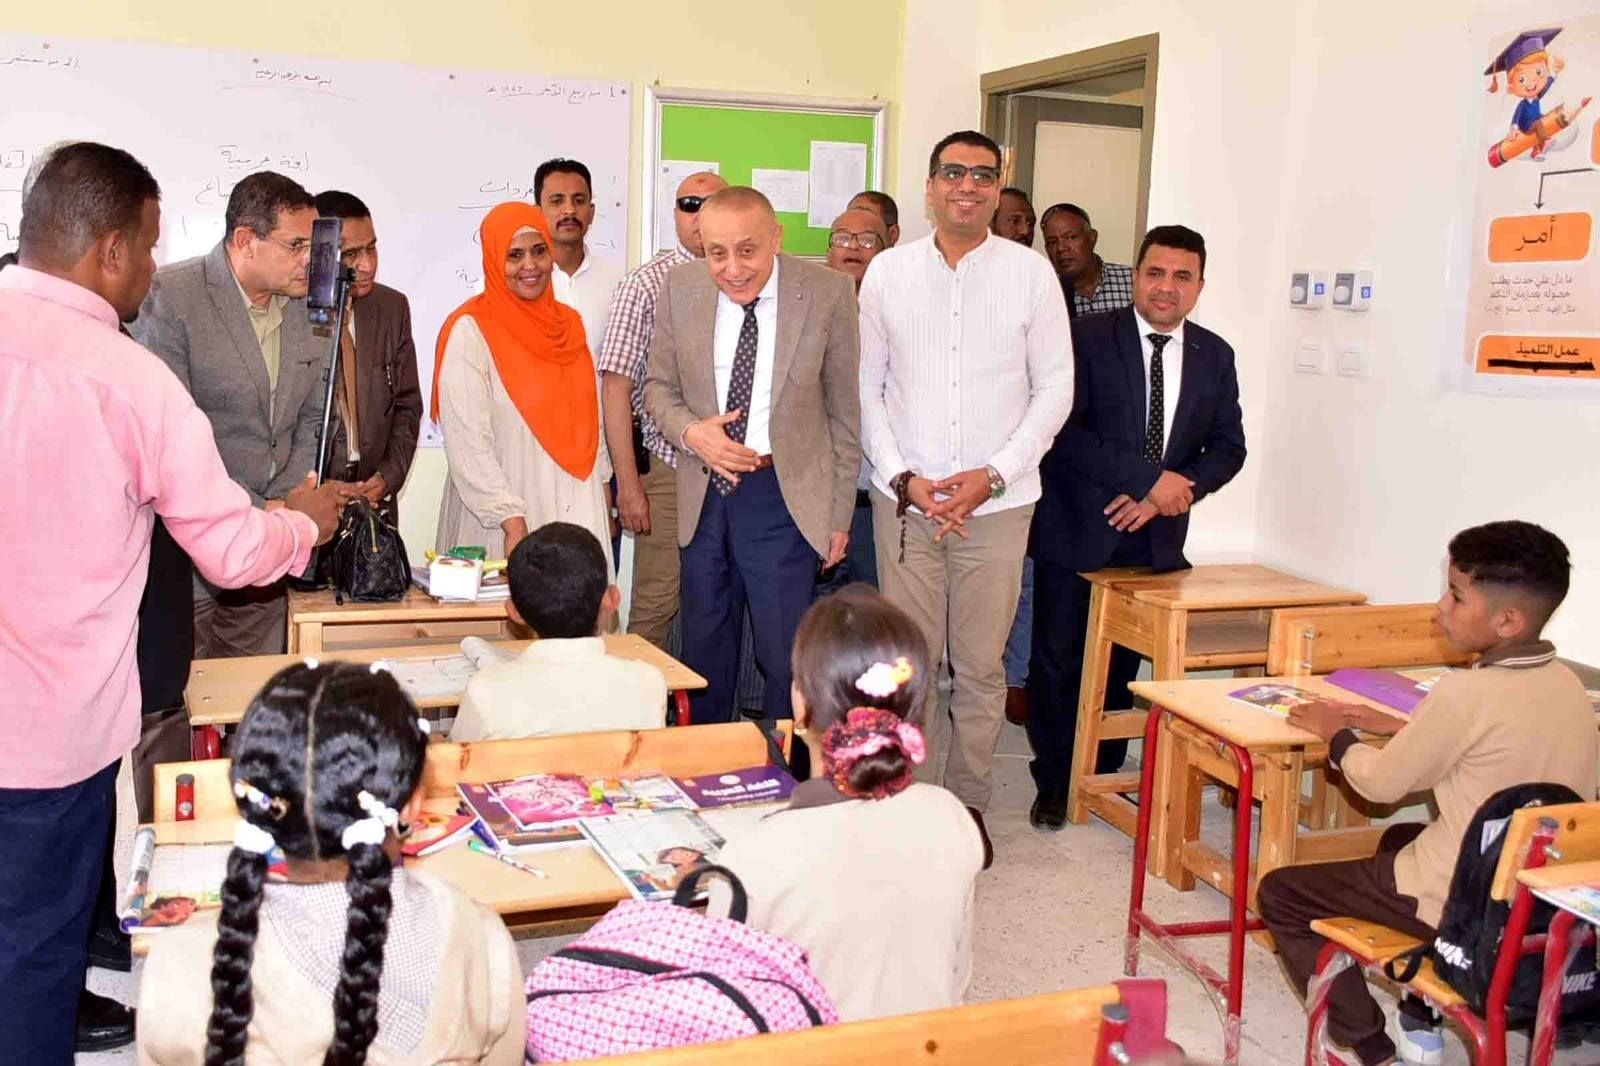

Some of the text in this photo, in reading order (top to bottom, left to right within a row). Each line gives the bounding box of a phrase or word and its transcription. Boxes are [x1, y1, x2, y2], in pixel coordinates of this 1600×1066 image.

[1515, 215, 1556, 251] أمر
[1515, 342, 1580, 358] عمل التلميذ
